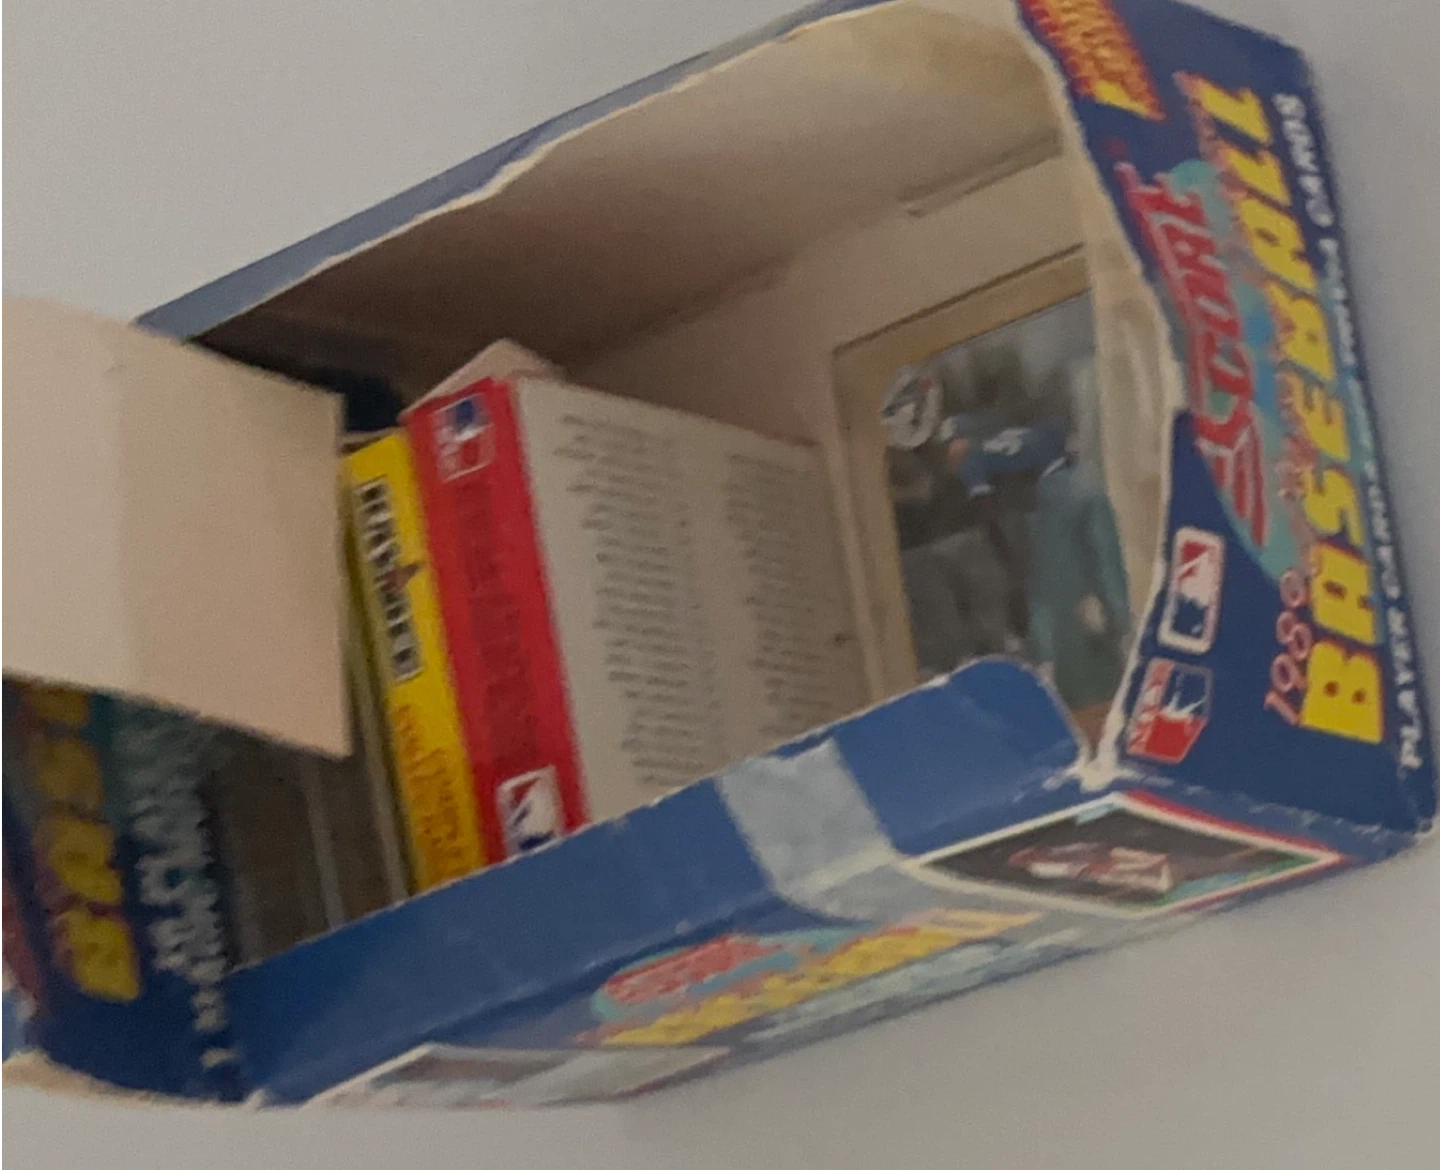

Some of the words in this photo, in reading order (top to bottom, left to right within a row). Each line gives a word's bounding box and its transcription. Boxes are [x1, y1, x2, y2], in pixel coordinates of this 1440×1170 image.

[1272, 92, 1335, 228] CARDS
[1186, 74, 1385, 744] BASEBALL
[1386, 605, 1424, 768] PLAYER
